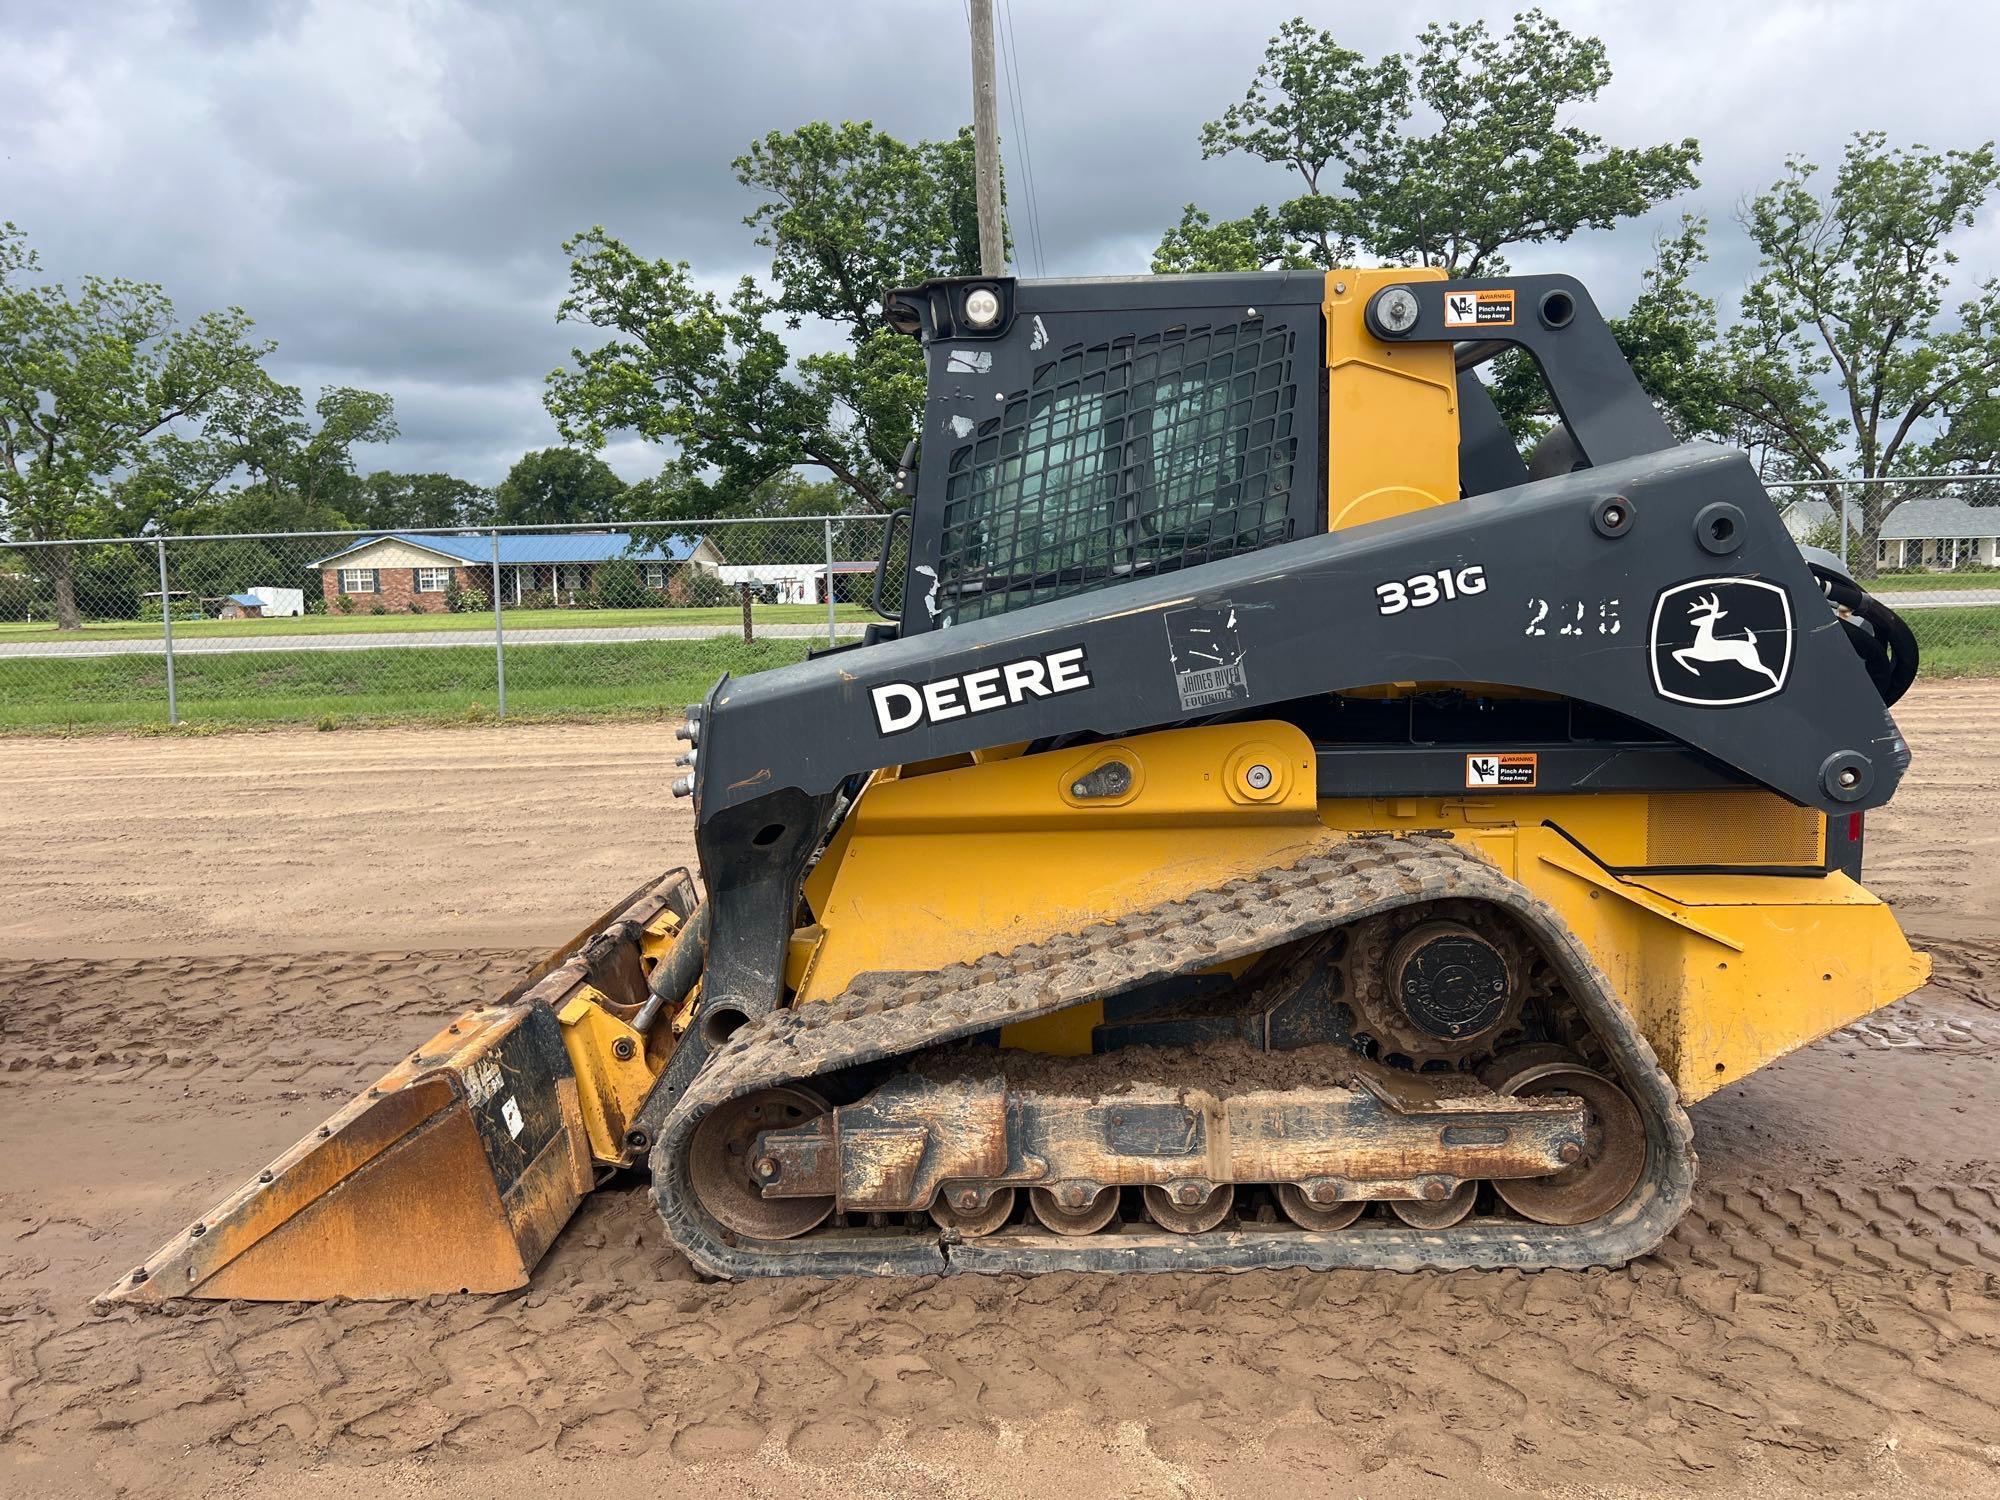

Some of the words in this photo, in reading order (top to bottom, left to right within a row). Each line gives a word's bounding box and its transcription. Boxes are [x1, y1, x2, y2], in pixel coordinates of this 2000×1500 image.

[1375, 565, 1488, 616] 331G
[871, 647, 1090, 734] DEERE
[1183, 672, 1214, 694] JAMES
